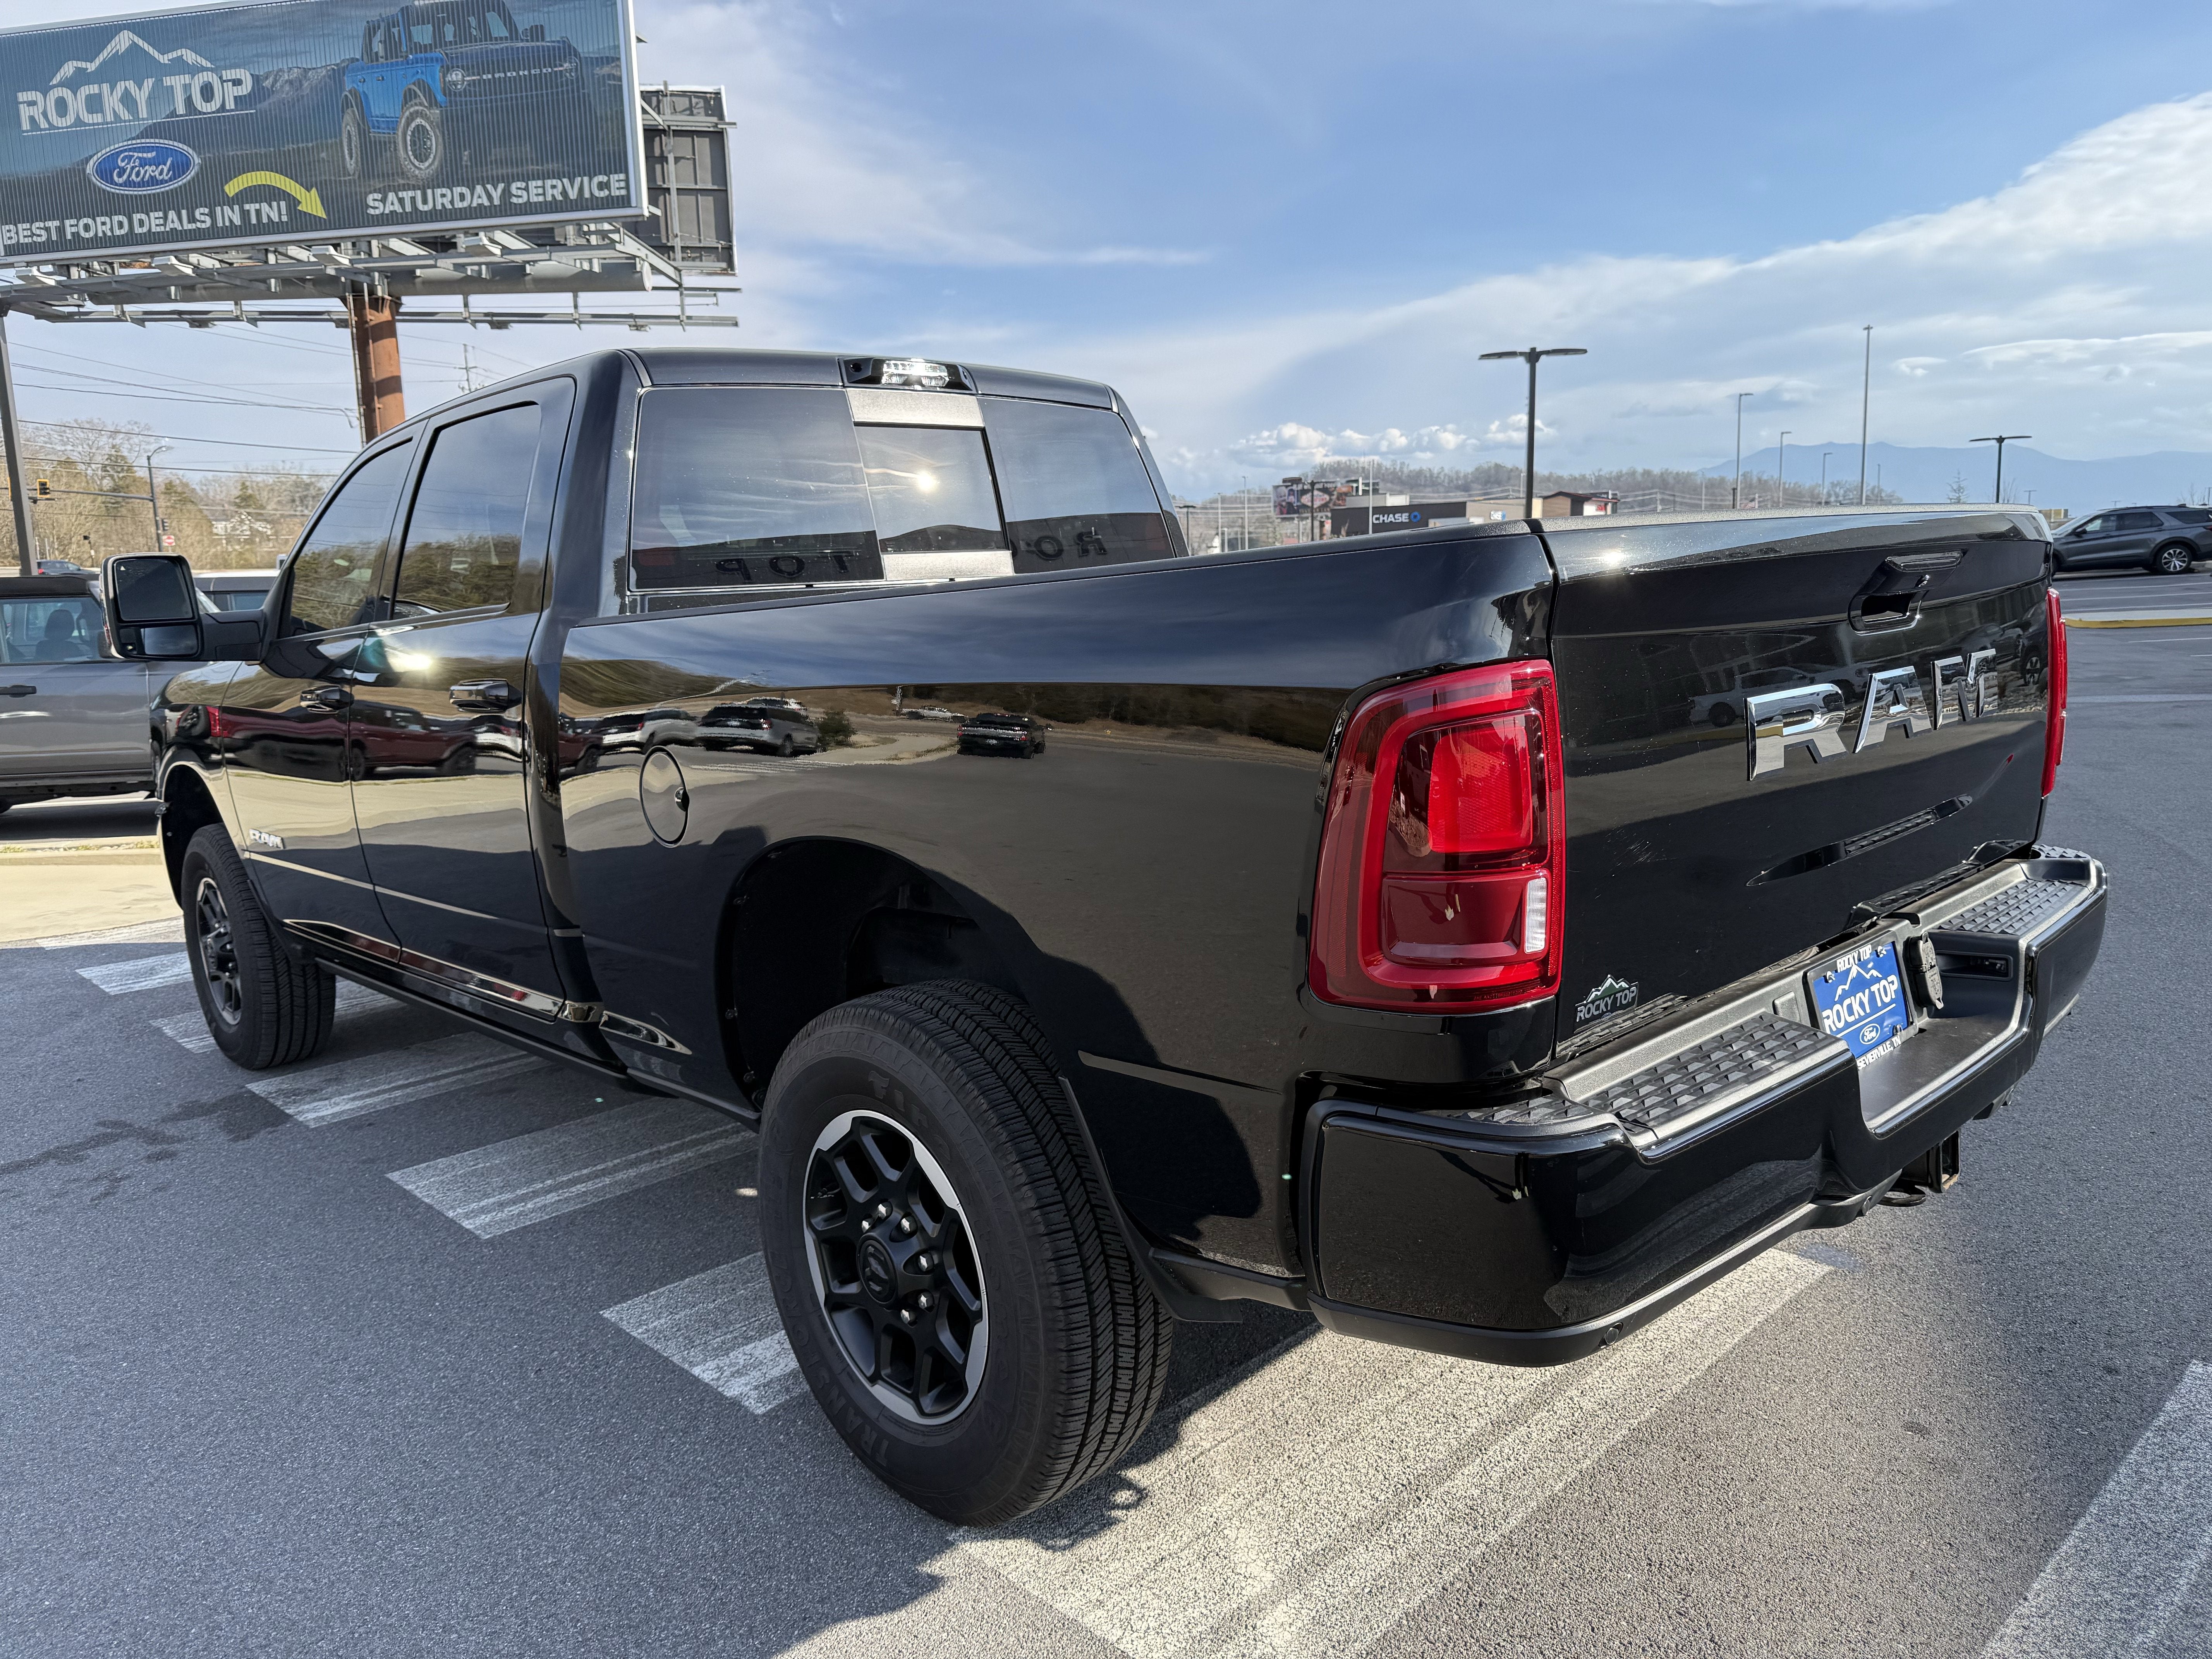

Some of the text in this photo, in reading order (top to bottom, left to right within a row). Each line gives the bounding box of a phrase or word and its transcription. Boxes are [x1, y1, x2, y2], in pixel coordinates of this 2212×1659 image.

[17, 68, 253, 131] ROCKY TOP
[113, 151, 173, 184] Ford
[366, 173, 627, 215] SATURDAY SERVICE
[2, 201, 288, 245] BEST FORD DEALS IN TN!
[1372, 513, 1409, 524] CHASE
[1744, 648, 1998, 781] RAM
[249, 829, 285, 850] RAM
[1837, 944, 1872, 973] ROCKY TOP
[1577, 986, 1637, 1022] ROCKY TOP
[1822, 988, 1870, 1034] ROCKY
[1870, 974, 1898, 1007] TOP
[1864, 1027, 1877, 1042] Ford
[1891, 1035, 1901, 1048] TN
